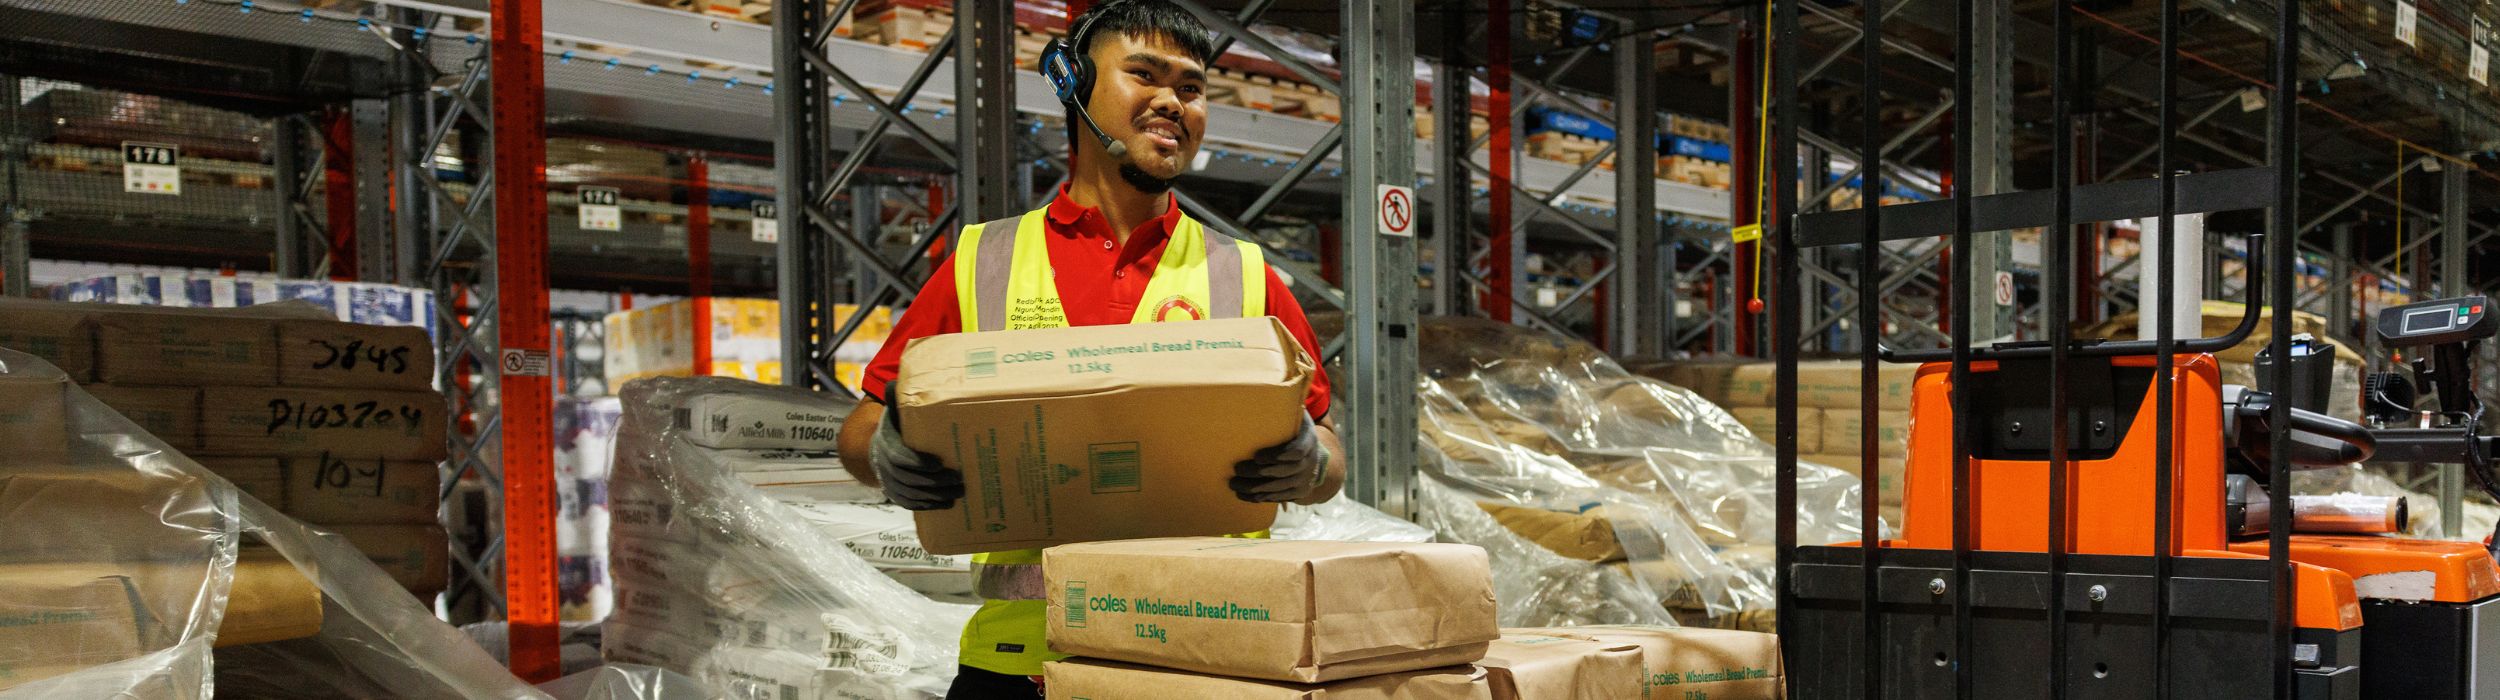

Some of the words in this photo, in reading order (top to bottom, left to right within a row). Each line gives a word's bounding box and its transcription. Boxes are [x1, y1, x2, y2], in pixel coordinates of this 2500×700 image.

[1002, 349, 1054, 364] coles
[1066, 343, 1148, 359] Wholemeal
[1151, 339, 1192, 353] Bread
[1196, 338, 1244, 350] Premix
[1068, 361, 1112, 375] 12.5kg
[786, 412, 804, 421] Coles
[767, 428, 785, 439] Mills
[791, 425, 834, 441] 110640
[879, 532, 896, 542] Coles
[880, 545, 922, 560] 110640
[1090, 594, 1127, 612] coles
[1135, 598, 1193, 617] Wholemeal
[1196, 601, 1227, 620] Bread
[1230, 604, 1270, 622] Premix
[1135, 623, 1167, 644] 12.5kg
[1653, 670, 1680, 686] coles
[1685, 665, 1725, 683] Wholemeal
